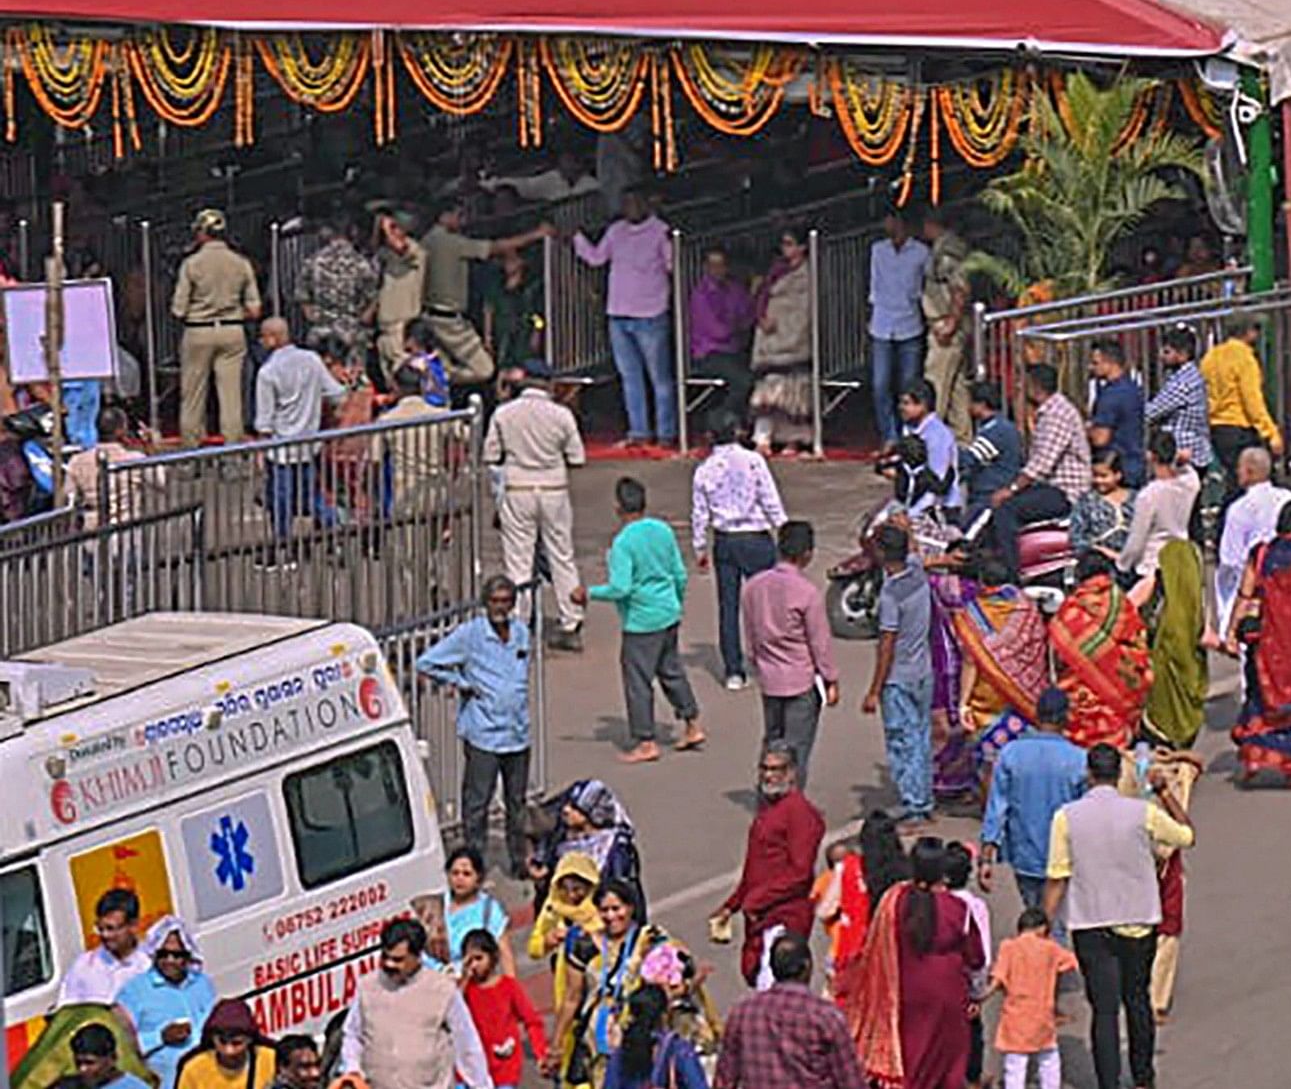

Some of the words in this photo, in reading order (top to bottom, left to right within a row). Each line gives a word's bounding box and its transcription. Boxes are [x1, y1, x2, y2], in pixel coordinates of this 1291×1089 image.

[80, 755, 165, 809] KHIMJI
[167, 694, 360, 780] FOUNDATION
[254, 952, 302, 988] BASIC
[304, 938, 338, 970] LIFE
